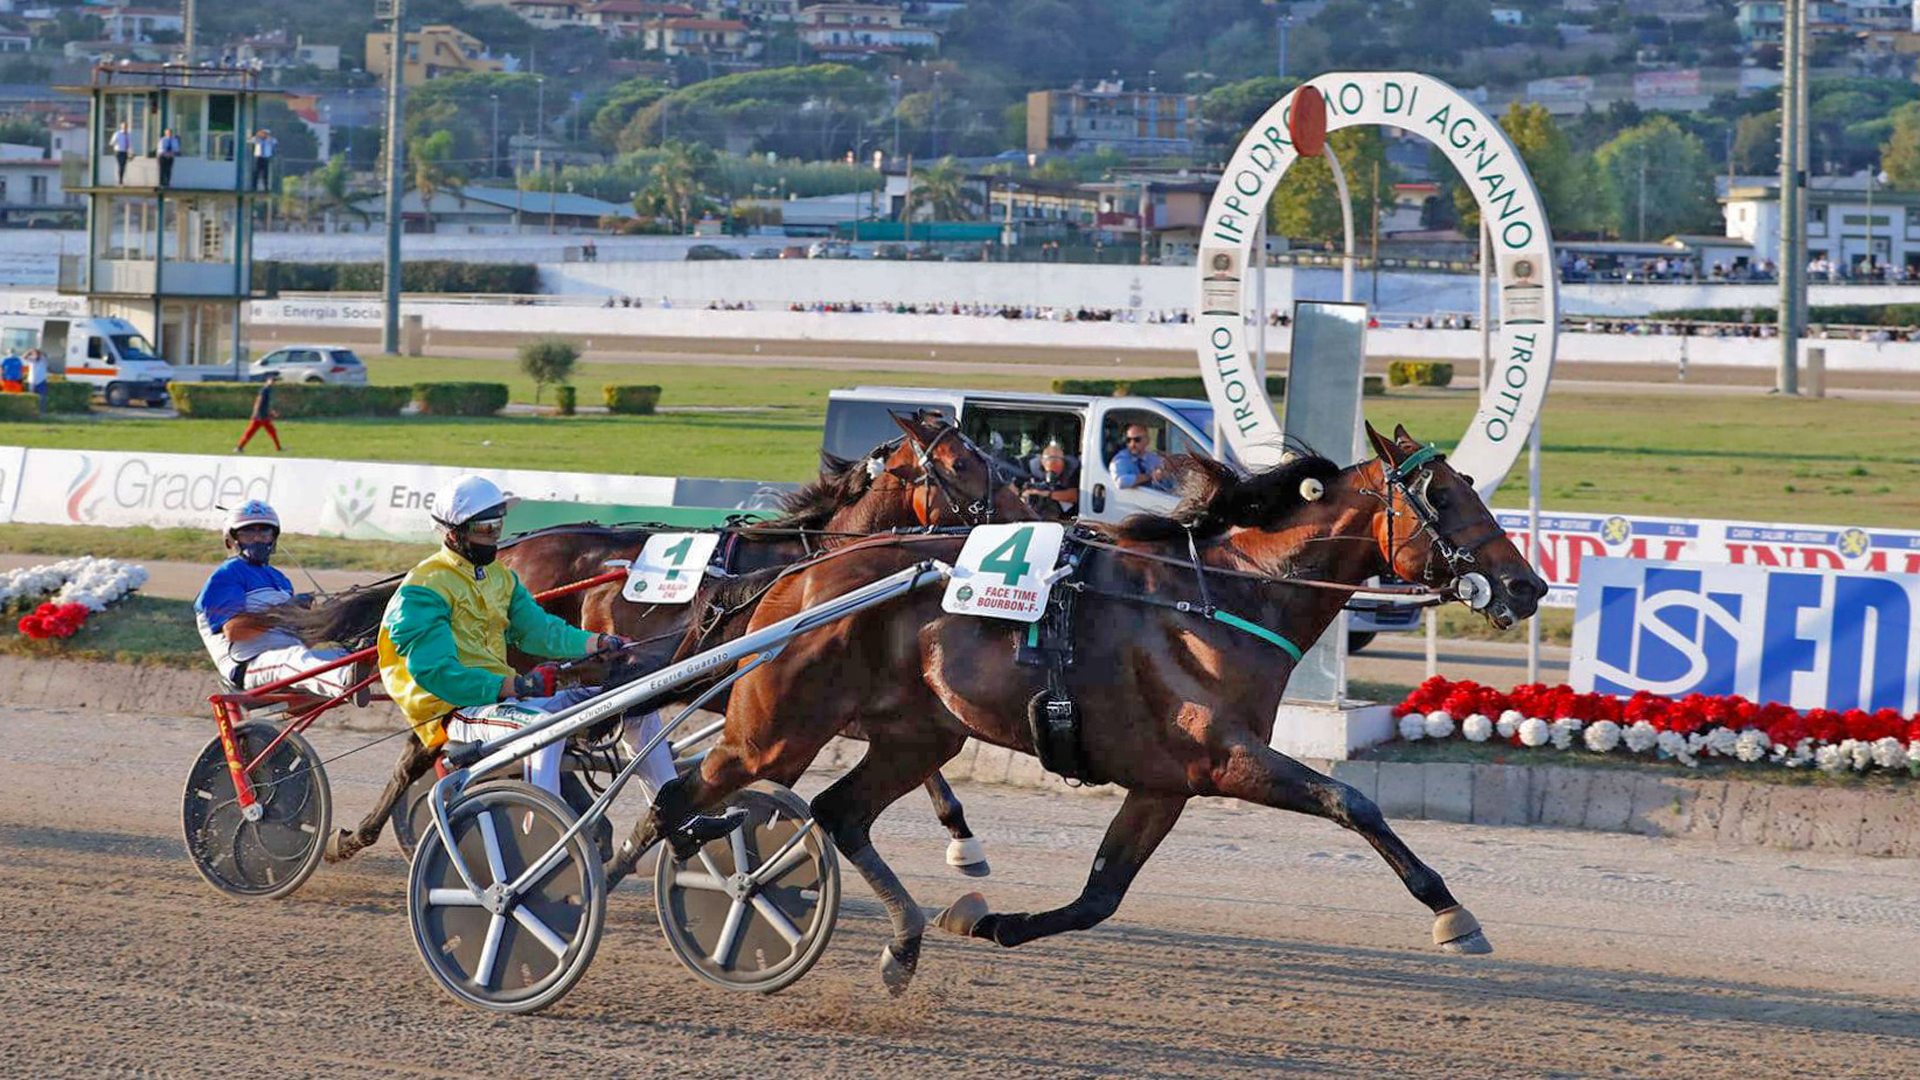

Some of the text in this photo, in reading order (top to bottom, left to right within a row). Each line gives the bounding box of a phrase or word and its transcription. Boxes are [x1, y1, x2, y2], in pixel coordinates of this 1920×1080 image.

[1214, 82, 1532, 249] IPPODRO DI AGNANO
[283, 305, 382, 319] Energia Socia
[1212, 327, 1257, 438] TROTTO
[1486, 333, 1535, 442] TROTTO
[114, 458, 275, 512] Graded
[663, 537, 694, 581] 1
[978, 526, 1034, 586] 4
[985, 587, 1038, 602] FACE TIME
[650, 652, 729, 690] Ecurie Guarato
[579, 701, 613, 722] Chrono
